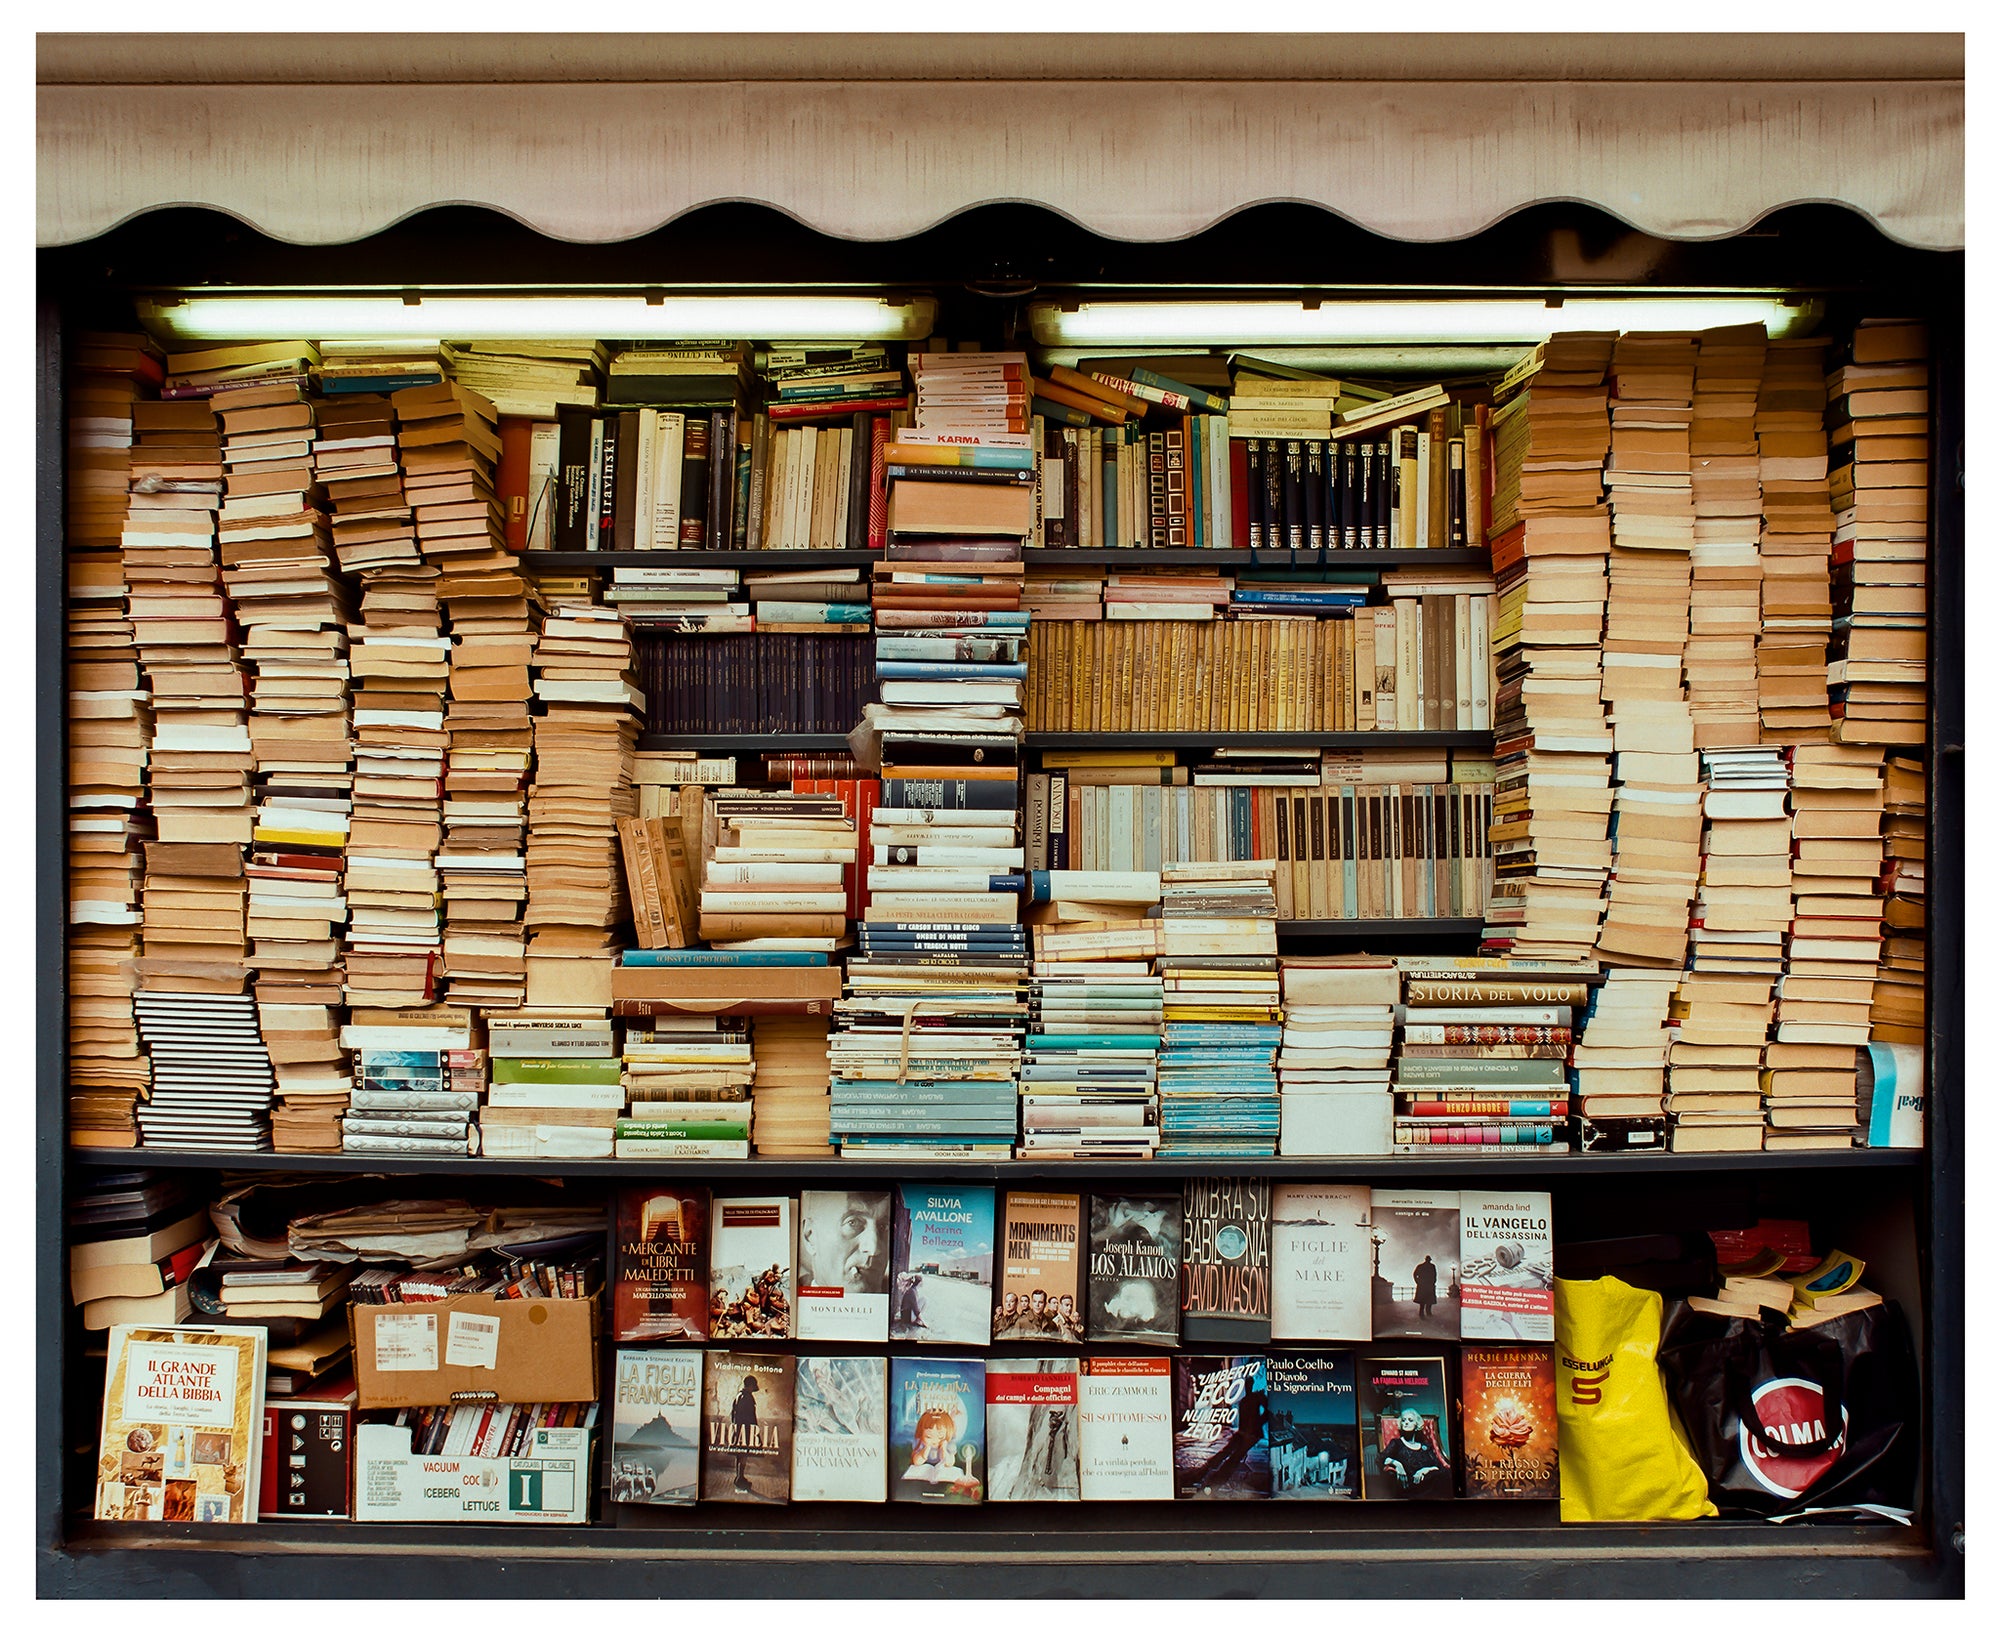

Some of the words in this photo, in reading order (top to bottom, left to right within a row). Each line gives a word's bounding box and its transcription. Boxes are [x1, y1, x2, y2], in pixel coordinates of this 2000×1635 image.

[937, 435, 981, 445] KARMA
[600, 438, 615, 528] Stravinski
[1052, 780, 1062, 831] TOSCANINI
[1032, 799, 1042, 848] Hollywood
[962, 924, 980, 932] GIOCO
[1409, 971, 1457, 979] ARCHITETTURA
[1416, 986, 1483, 1001] STORIA
[1489, 990, 1513, 1000] DEL
[1520, 987, 1570, 1001] VOLO
[1446, 1104, 1470, 1113] RENZO
[1472, 1104, 1500, 1113] ARBORE
[1897, 1096, 1923, 1112] Beal
[927, 1197, 961, 1209] SILVIA
[1184, 1177, 1243, 1219] OMBRA
[1247, 1177, 1269, 1221] SU
[1482, 1203, 1514, 1212] amanda
[1515, 1203, 1531, 1212] lind
[915, 1211, 973, 1223] AVALLONE
[924, 1224, 963, 1235] Marina
[1466, 1217, 1478, 1228] IL
[1483, 1217, 1547, 1230] VANGELO
[1009, 1221, 1076, 1243] MONUMENTS
[1466, 1230, 1548, 1241] DELL'ASSASSINA
[921, 1236, 964, 1248] Bellezza
[1291, 1240, 1349, 1253] FIGLIE
[628, 1243, 697, 1255] MERCANTE
[1008, 1241, 1030, 1260] MEN
[1104, 1239, 1133, 1258] Joseph
[1136, 1240, 1164, 1256] Kanon
[641, 1258, 649, 1266] DI
[650, 1256, 678, 1268] LIBRI
[1090, 1254, 1115, 1275] LOS
[1118, 1255, 1176, 1279] ALAMOS
[1312, 1257, 1324, 1265] del
[624, 1269, 694, 1281] MALEDETTI
[1295, 1270, 1345, 1282] MARE
[1182, 1264, 1219, 1311] DAVID
[1221, 1265, 1269, 1314] MASON
[810, 1305, 873, 1314] MONTANELLI
[1467, 1353, 1500, 1362] HERBIE
[1504, 1353, 1548, 1362] BRENNAN
[1562, 1354, 1614, 1371] ESSELUNGA
[148, 1360, 159, 1372] IL
[161, 1361, 217, 1375] GRANDE
[715, 1362, 751, 1372] Vladimiro
[754, 1364, 783, 1374] Bottone
[1267, 1358, 1294, 1370] Paulo
[1295, 1358, 1334, 1370] Coelho
[620, 1363, 639, 1383] LA
[646, 1365, 696, 1386] FIGLIA
[1200, 1362, 1260, 1385] UMBERTO
[1267, 1372, 1273, 1382] Il
[1275, 1372, 1308, 1382] Diavolo
[1485, 1372, 1495, 1380] LA
[1497, 1372, 1532, 1380] GUERRA
[153, 1373, 211, 1388] ATLANTE
[905, 1381, 918, 1391] LA
[1380, 1378, 1403, 1386] FAMIGLIA
[1404, 1378, 1429, 1386] MELROSE
[1485, 1380, 1511, 1388] DEGLI
[1513, 1380, 1532, 1388] ELFI
[138, 1386, 179, 1399] DELLA
[182, 1388, 222, 1402] BIBBIA
[1034, 1385, 1071, 1394] Compagni
[1112, 1387, 1157, 1396] ZEMMOUR
[1197, 1379, 1246, 1406] ECO
[1274, 1382, 1282, 1392] la
[1283, 1382, 1325, 1395] Signorina
[1327, 1382, 1352, 1395] Prym
[619, 1384, 696, 1406] FRANCESE
[1006, 1394, 1026, 1402] campi
[1097, 1414, 1167, 1423] SOTTOMESSO
[1182, 1408, 1238, 1423] NUMERO
[1183, 1423, 1222, 1441] ZERO
[796, 1447, 832, 1457] STORIA
[834, 1448, 877, 1457] UMANA
[423, 1463, 460, 1473] VACUUM
[806, 1457, 859, 1468] INUMANA
[1094, 1458, 1104, 1466] La
[1130, 1458, 1156, 1467] perduta
[1484, 1459, 1495, 1469] IL
[1500, 1458, 1540, 1469] REGNO
[1082, 1468, 1093, 1476] che
[1104, 1470, 1136, 1478] consegna
[1475, 1470, 1487, 1480] IN
[1491, 1470, 1550, 1481] PERICOLO
[424, 1488, 460, 1498] ICEBERG
[520, 1475, 532, 1506] I
[463, 1501, 500, 1511] LETTUCE
